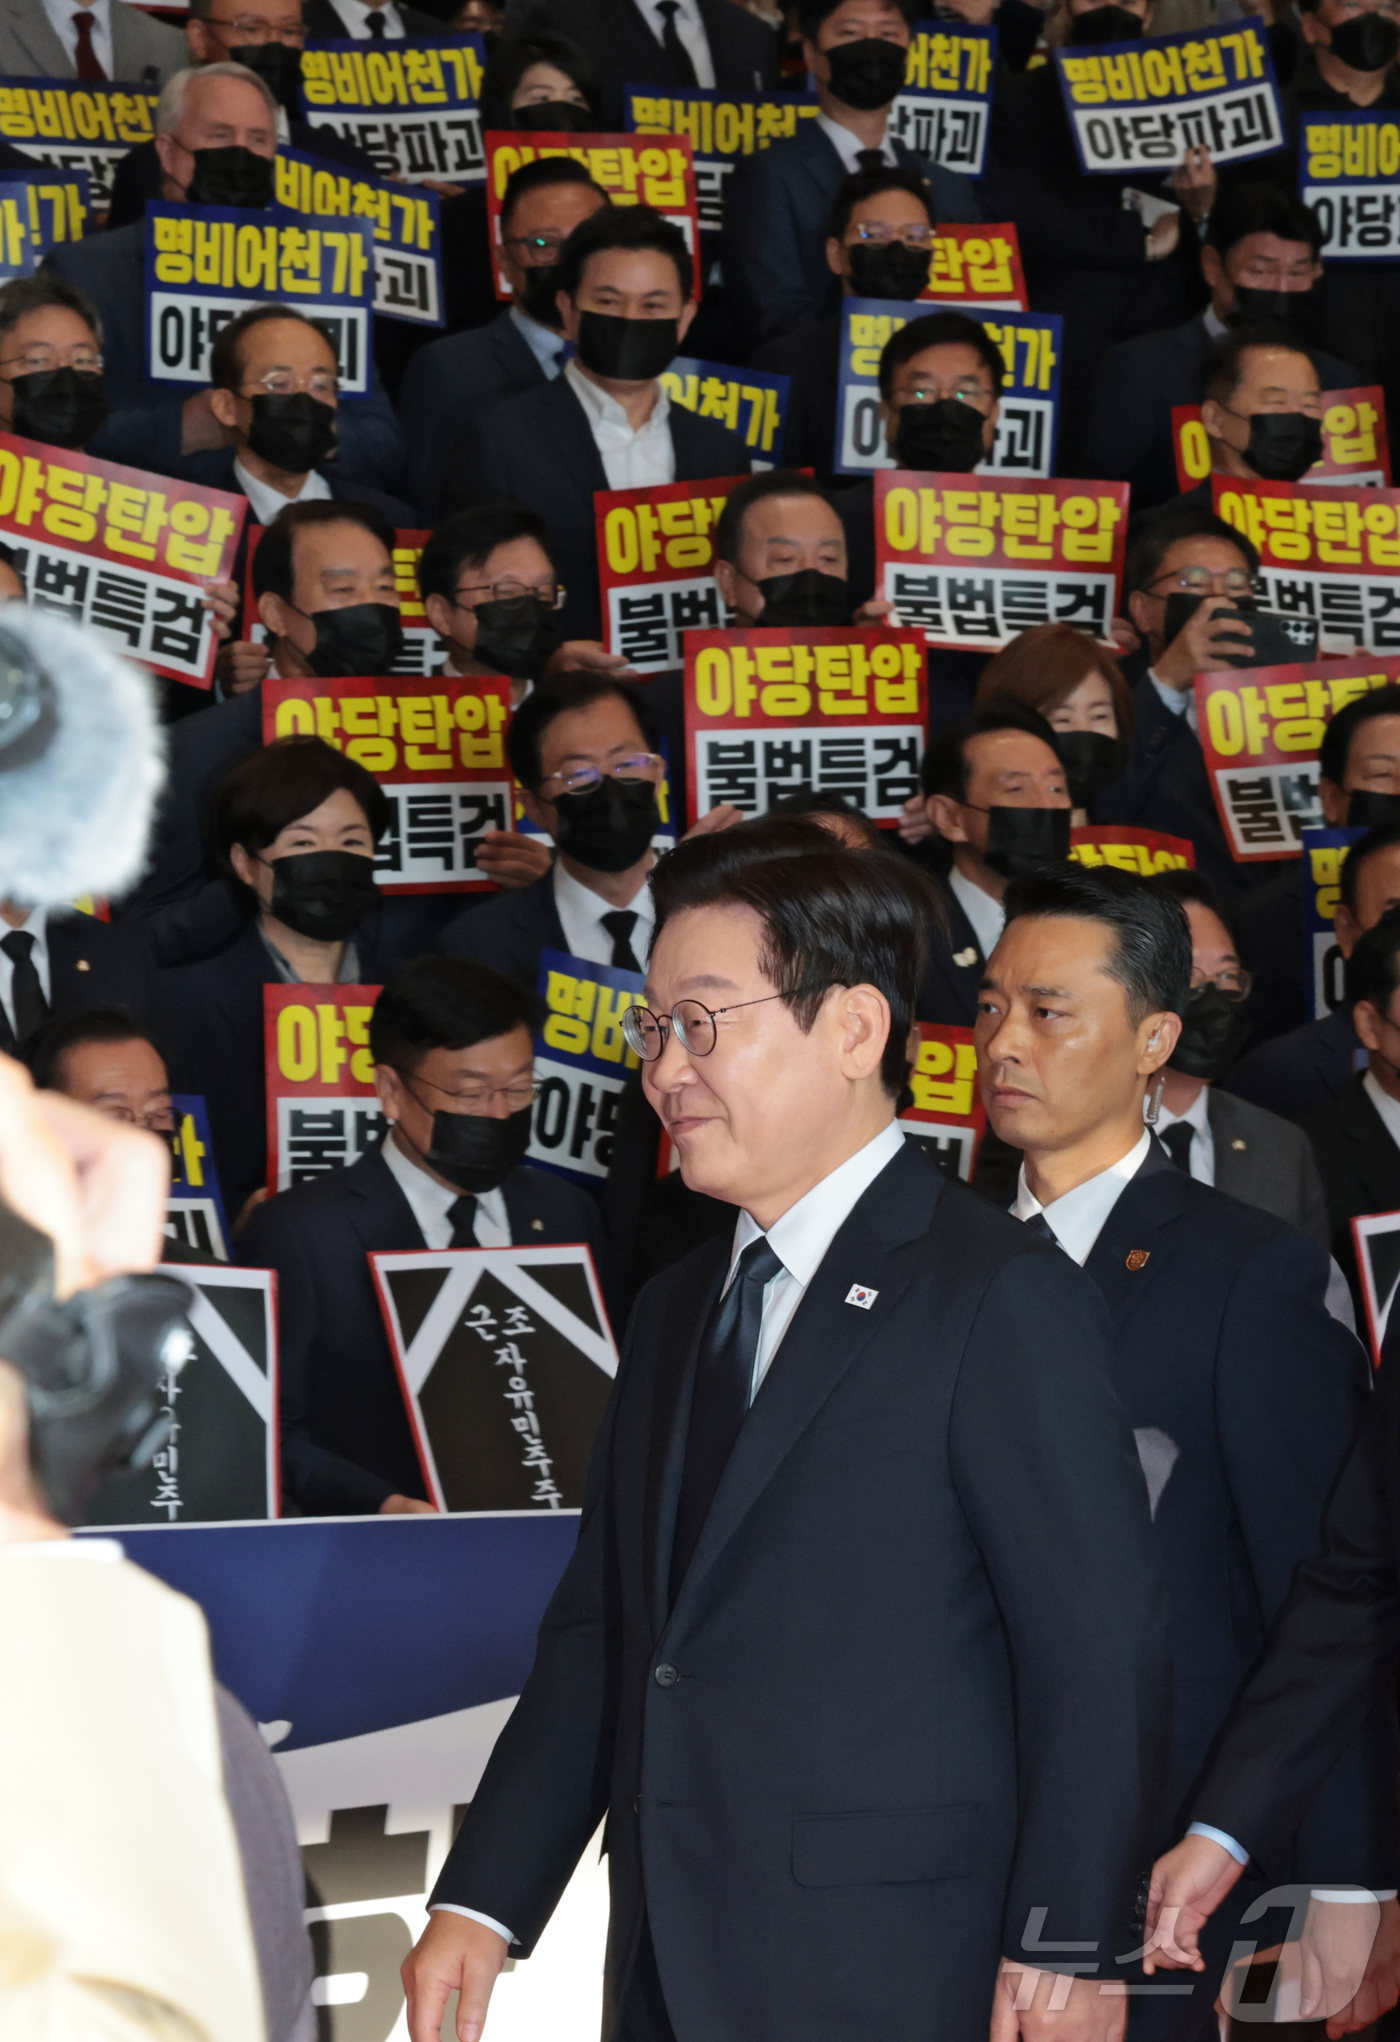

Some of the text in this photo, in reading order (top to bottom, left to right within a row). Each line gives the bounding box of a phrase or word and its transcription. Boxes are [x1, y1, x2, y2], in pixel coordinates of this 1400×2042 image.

[302, 48, 484, 106] 명비어천가
[1062, 28, 1265, 104] 명비어천가
[0, 87, 160, 143] 명비어천
[632, 96, 822, 156] 명비어천
[1085, 92, 1274, 163] 야당파괴
[153, 216, 368, 297] 명비어천가
[0, 449, 236, 578] 야당탄압
[603, 495, 728, 575] 야당
[884, 486, 1121, 563] 야당탄압
[10, 545, 205, 665] 법특검
[695, 643, 922, 718] 야당탄압
[275, 695, 507, 771] 야당탄압
[464, 1304, 536, 1341] 근조
